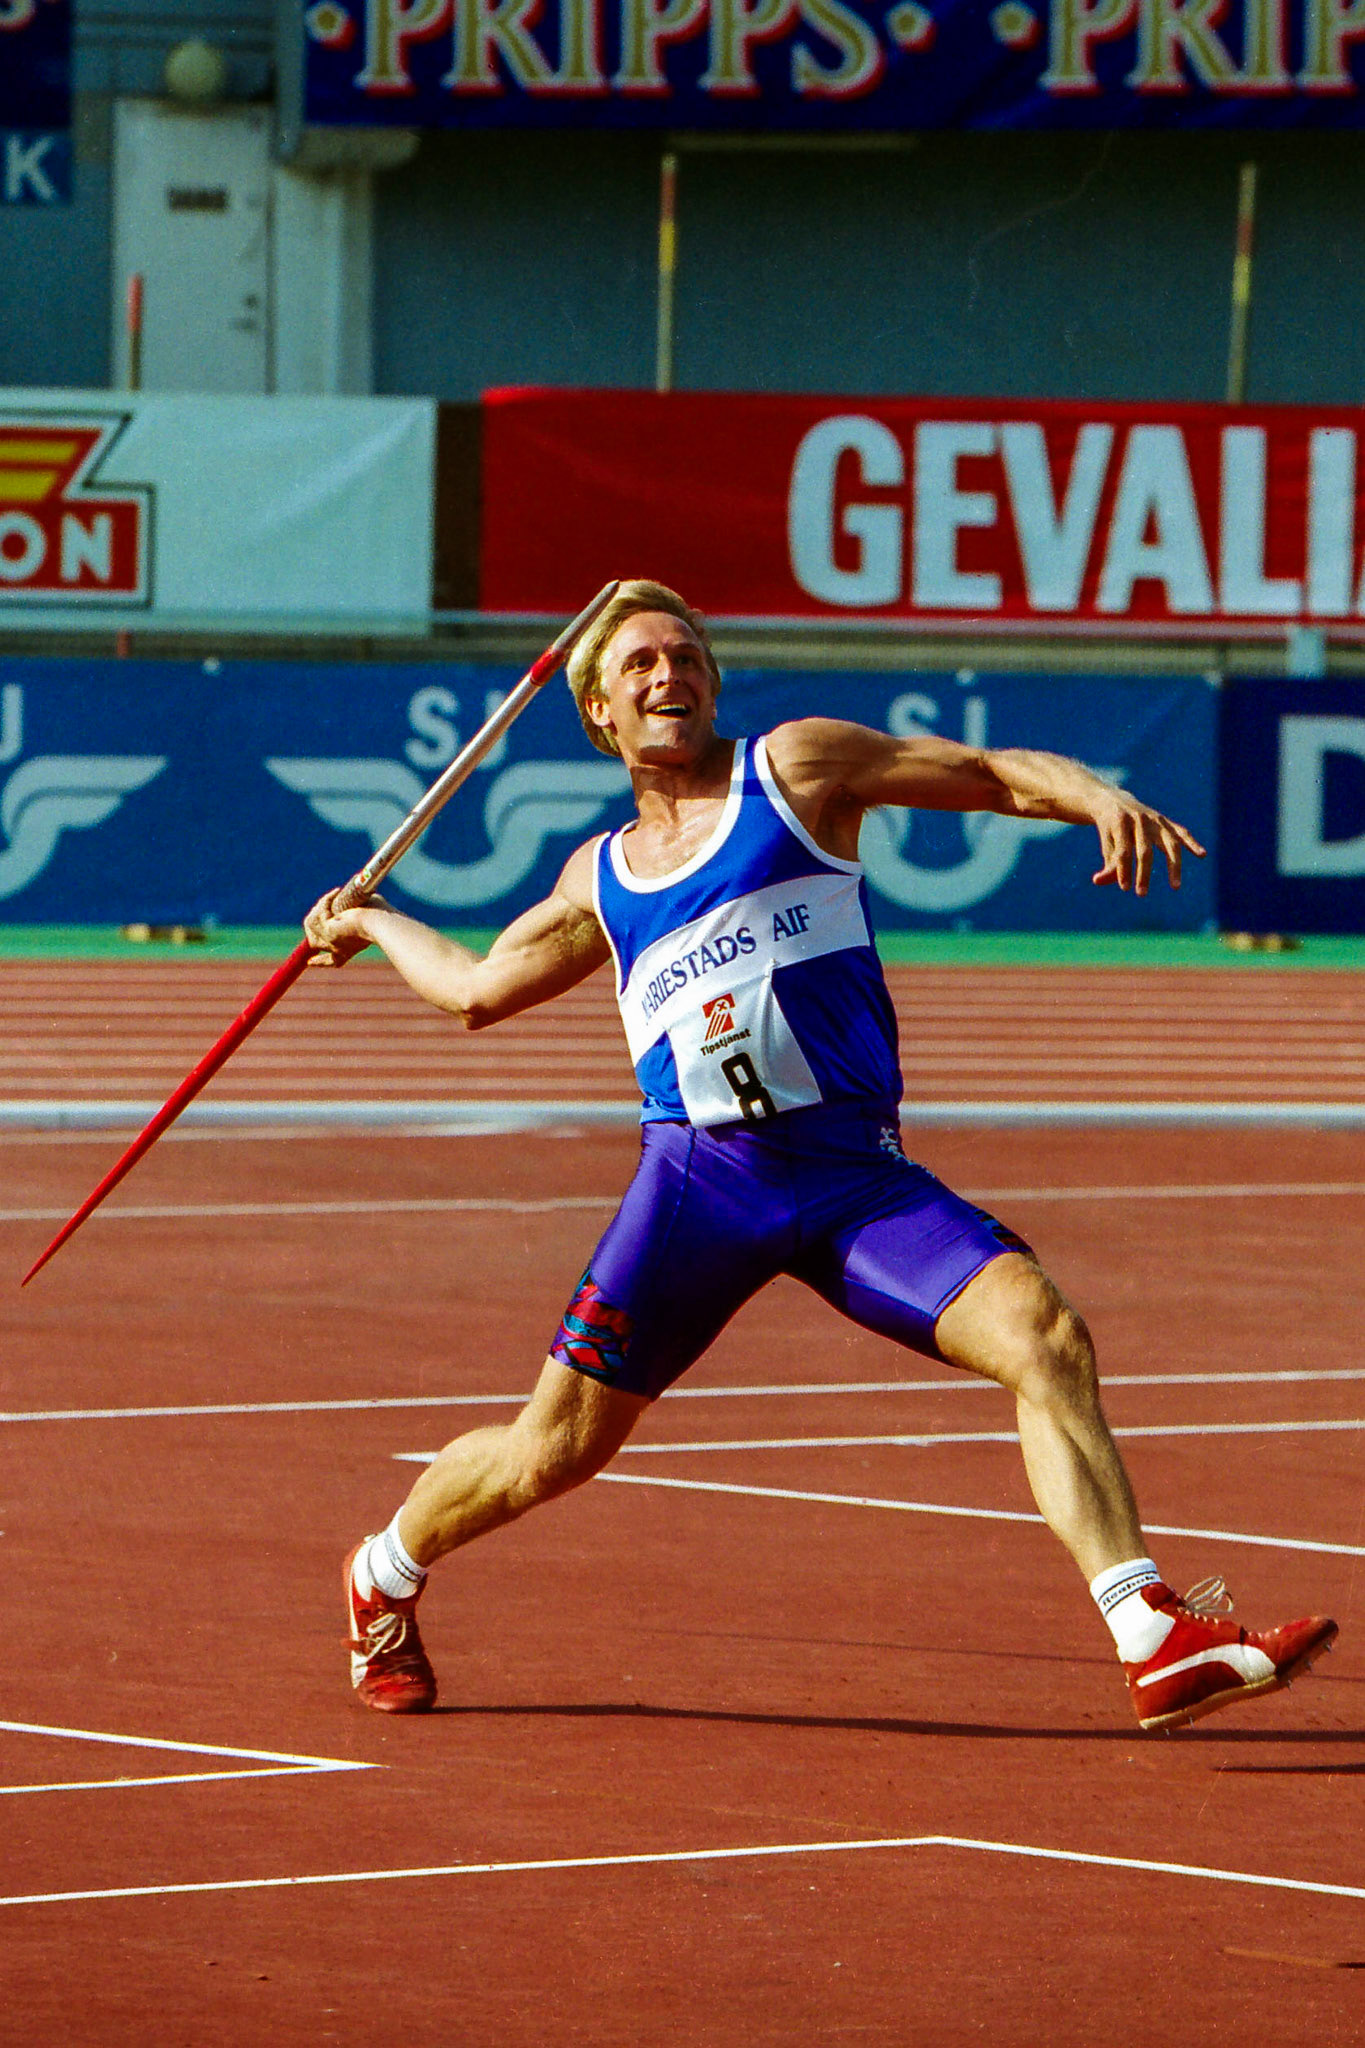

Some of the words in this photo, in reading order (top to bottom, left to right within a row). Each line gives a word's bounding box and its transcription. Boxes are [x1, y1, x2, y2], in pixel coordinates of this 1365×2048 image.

[356, 0, 882, 93] PRIPPS
[788, 414, 1365, 616] GEVALI
[773, 903, 810, 941] AIF
[721, 1052, 778, 1120] 8
